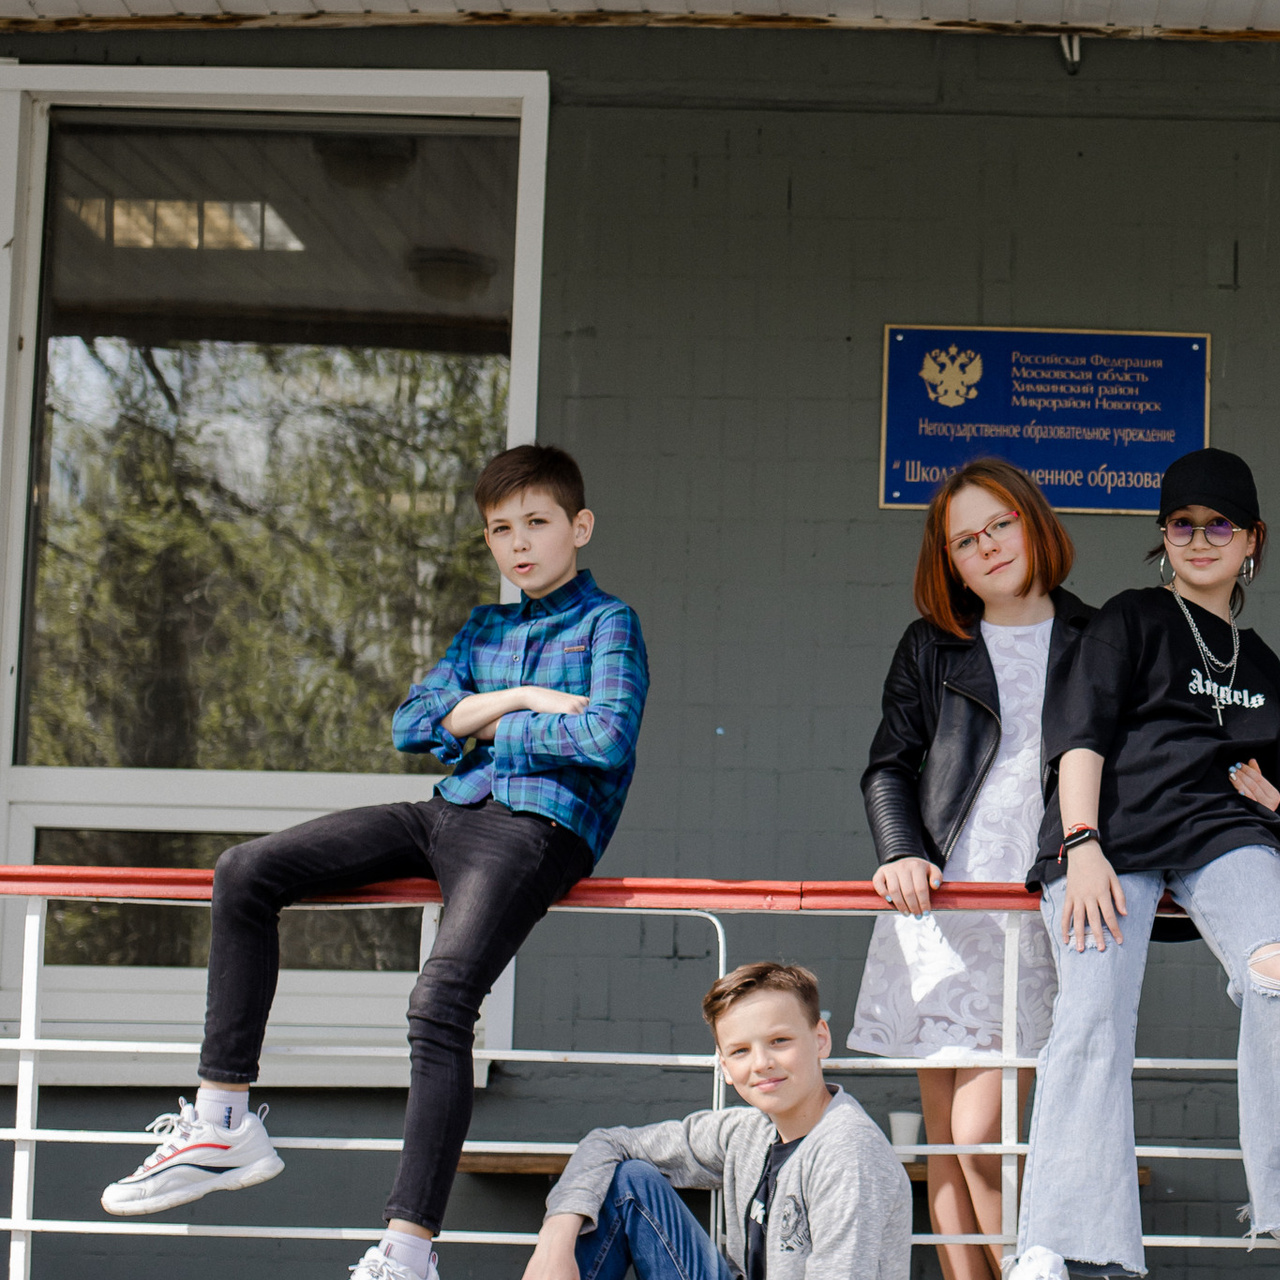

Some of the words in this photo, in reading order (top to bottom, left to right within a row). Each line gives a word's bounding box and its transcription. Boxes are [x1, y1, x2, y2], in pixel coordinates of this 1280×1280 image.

[1011, 351, 1086, 366] Российская
[1090, 354, 1163, 371] Федерация
[1011, 366, 1093, 380] Московская
[1096, 368, 1149, 383] область
[1012, 380, 1094, 394] Химкинский
[1098, 383, 1139, 398] район
[1011, 395, 1091, 412] Микрорайон
[1095, 397, 1161, 415] Новогорск
[918, 417, 1021, 442] Негосударственное
[1023, 419, 1111, 444] образовательное
[1113, 427, 1176, 447] учреждение
